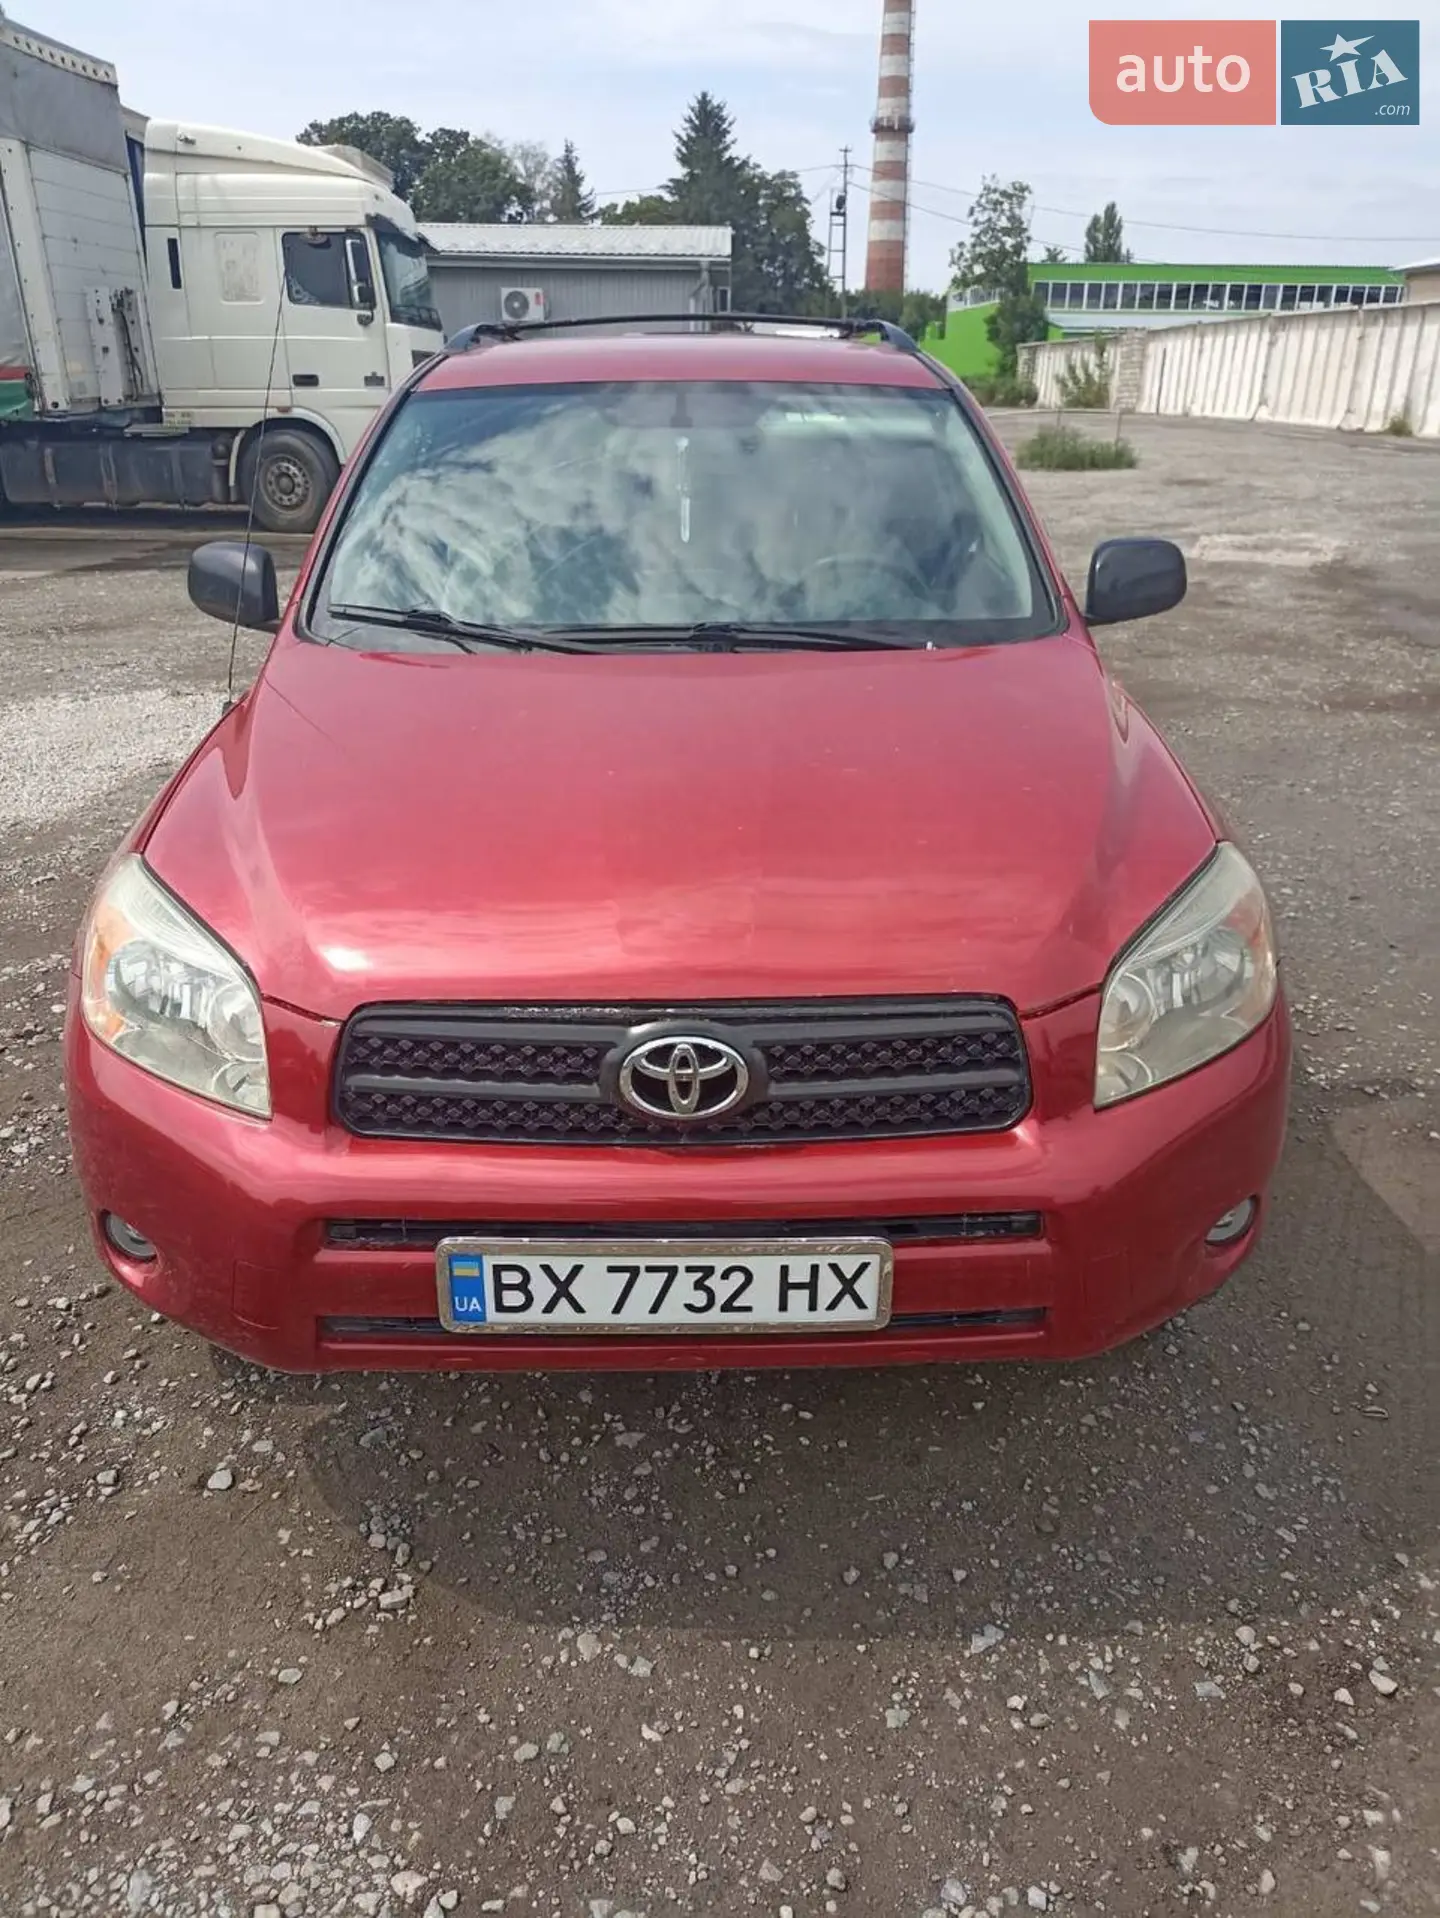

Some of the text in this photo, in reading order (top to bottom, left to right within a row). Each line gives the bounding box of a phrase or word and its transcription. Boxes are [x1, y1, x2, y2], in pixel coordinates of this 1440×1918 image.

[454, 1297, 482, 1312] UA
[492, 1262, 869, 1315] BX 7732 HX
